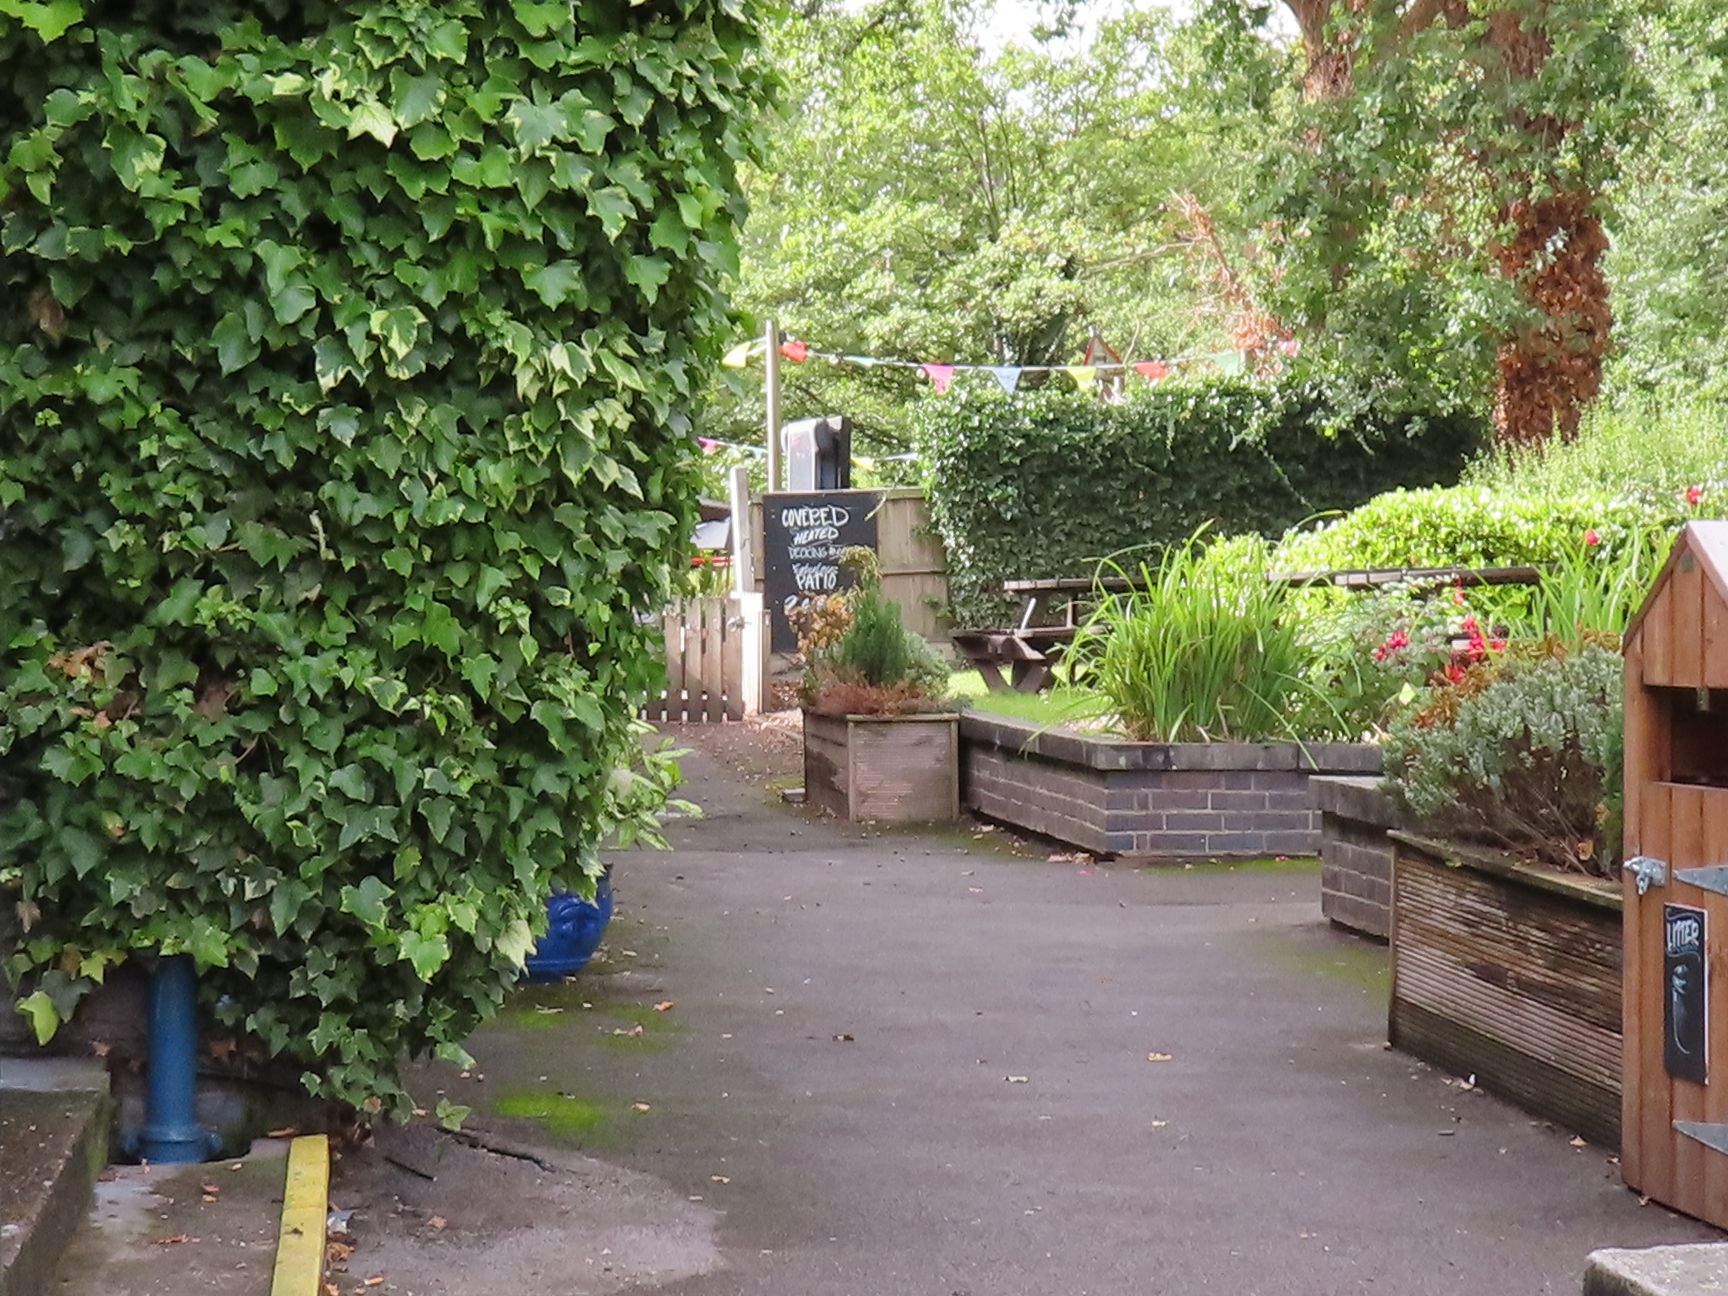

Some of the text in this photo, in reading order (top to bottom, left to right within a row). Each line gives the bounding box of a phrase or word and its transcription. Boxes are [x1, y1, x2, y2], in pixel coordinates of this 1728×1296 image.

[781, 506, 850, 528] COVERED
[793, 527, 840, 545] HEATED
[796, 572, 837, 591] PATIO
[1666, 918, 1700, 952] LITTER
